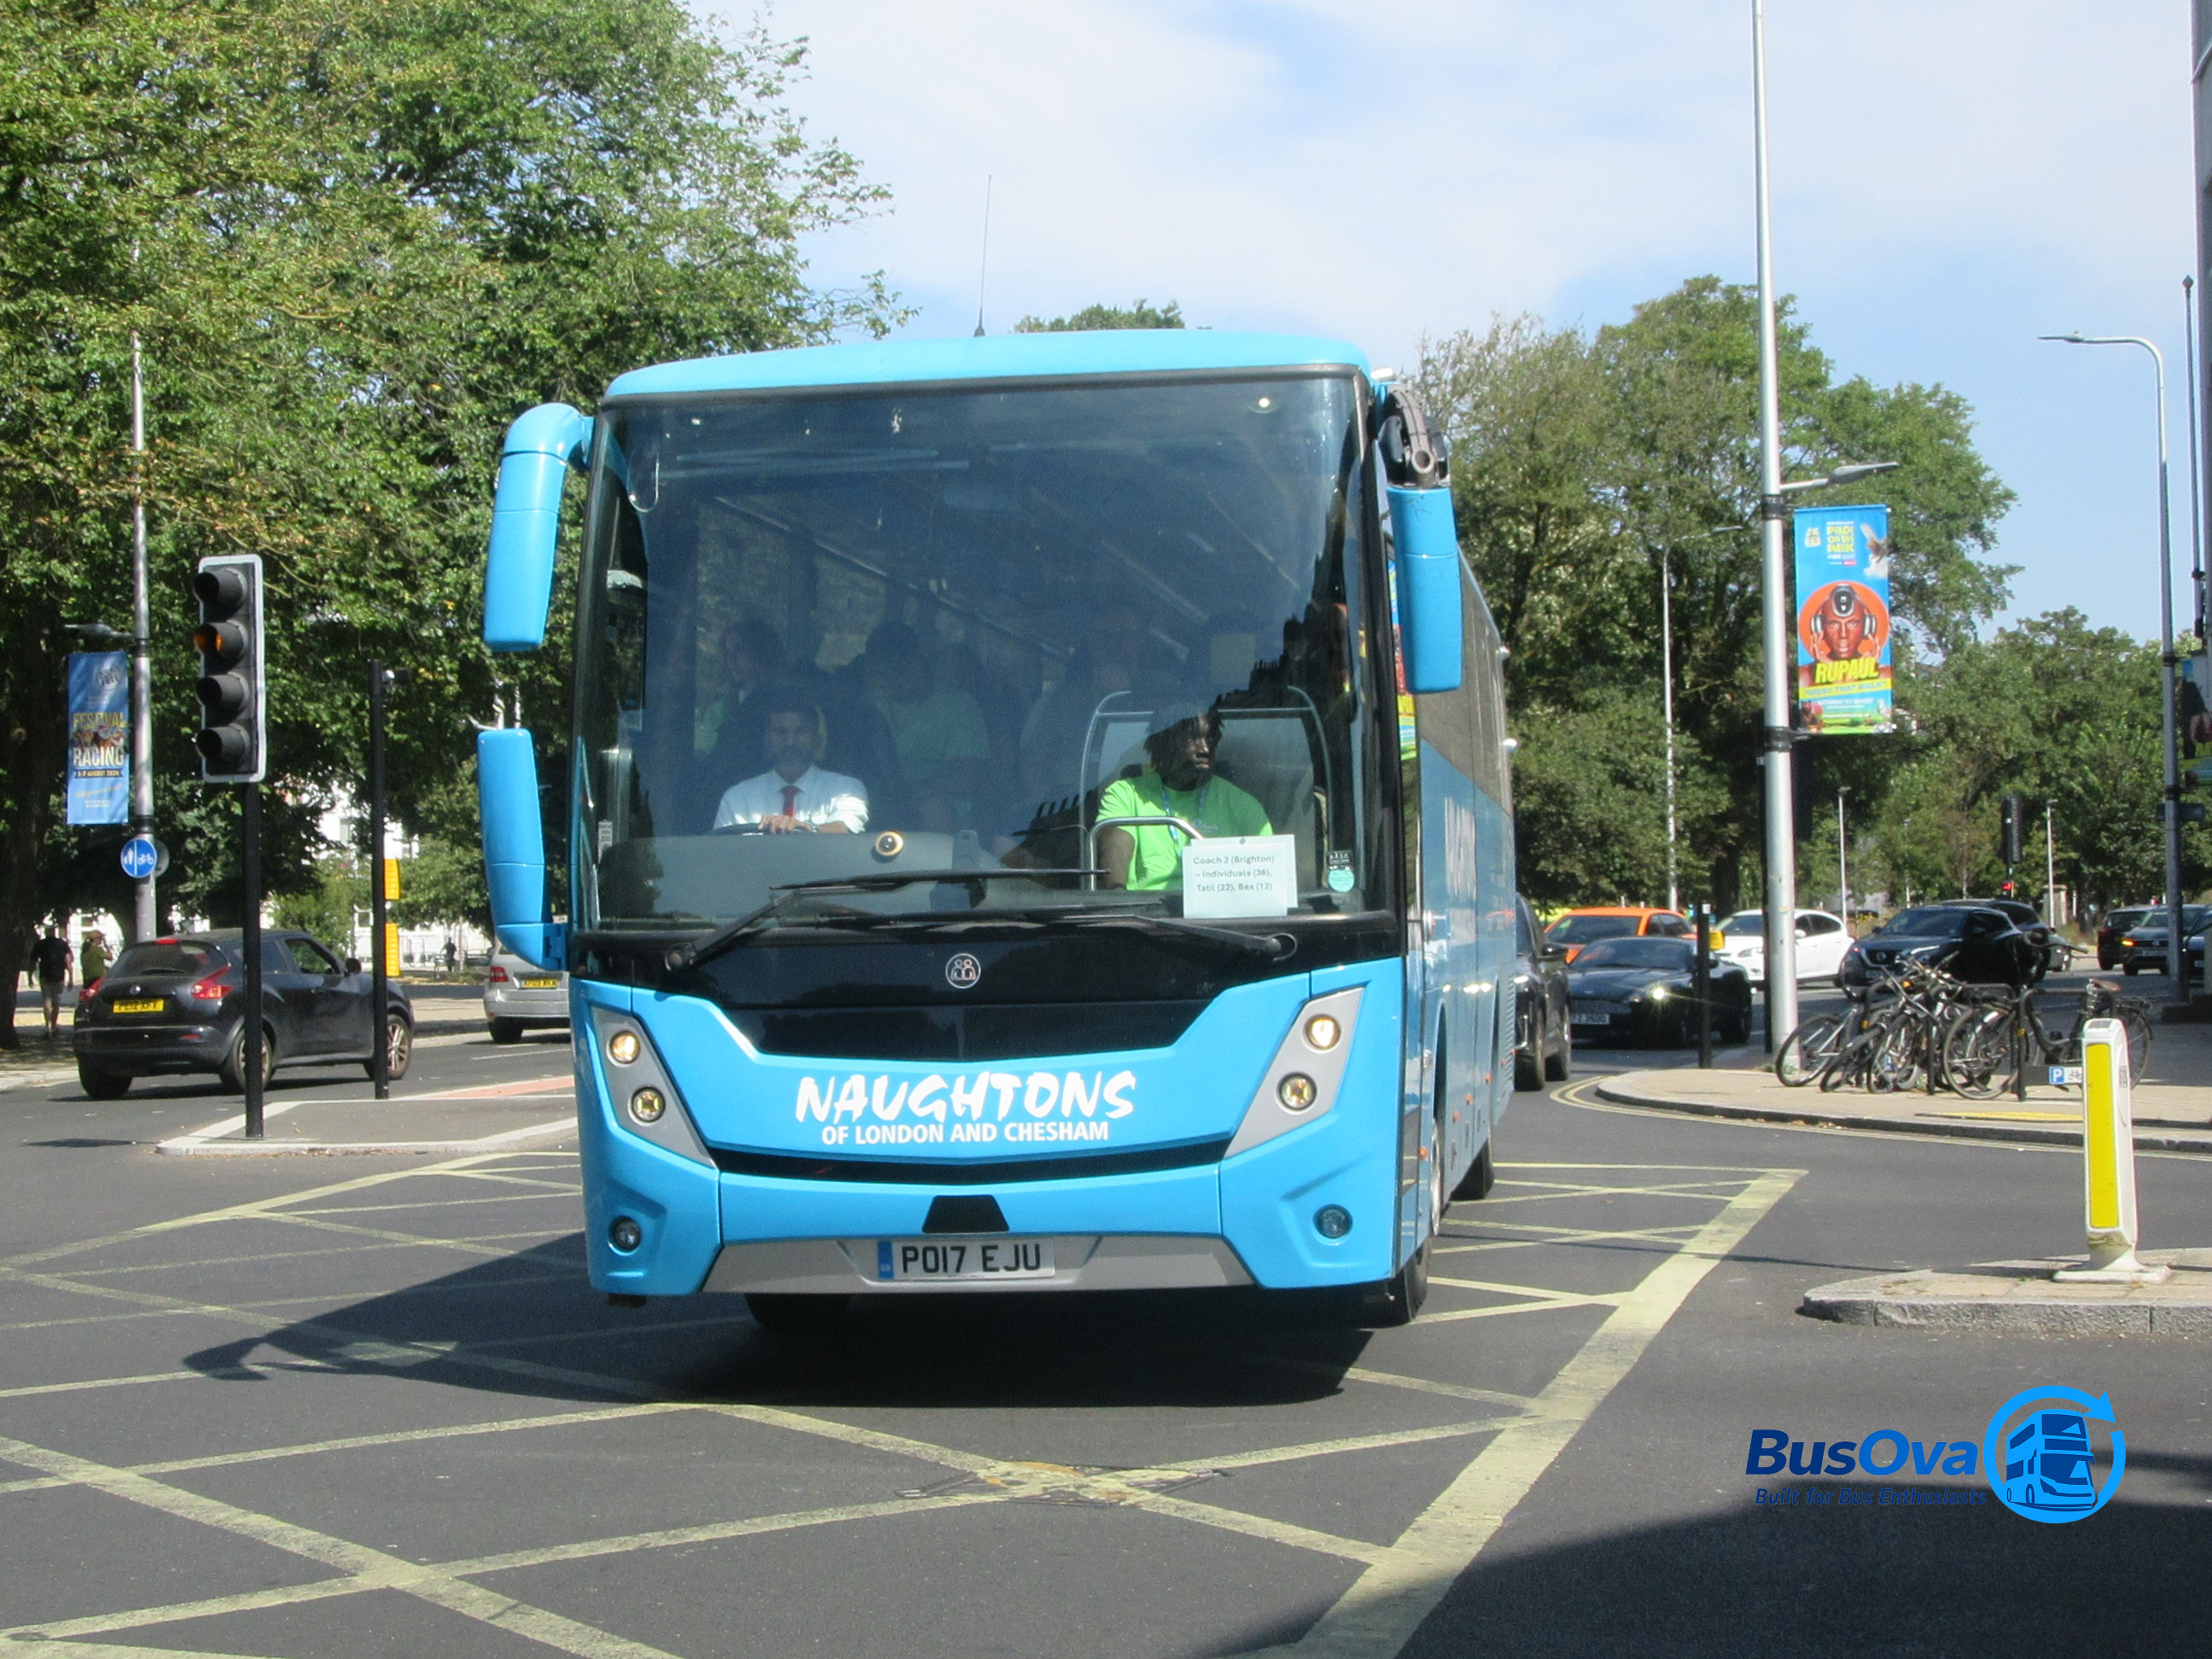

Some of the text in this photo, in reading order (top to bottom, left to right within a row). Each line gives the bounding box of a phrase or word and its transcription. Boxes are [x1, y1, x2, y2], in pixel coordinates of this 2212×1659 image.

[1815, 657, 1879, 684] RUPAUL
[73, 712, 127, 729] FESTIVAL
[73, 745, 125, 766] RACING
[1193, 854, 1275, 865] Coach 2 (Brighton)
[1202, 869, 1251, 878] Individuals
[1256, 882, 1272, 892] (12)
[2053, 1069, 2062, 1082] P
[795, 1071, 1136, 1124] NAUGHTONS
[822, 1121, 1109, 1144] OF LONDON AND CHESHAM
[901, 1246, 966, 1273] PO17
[981, 1243, 1041, 1272] EJU
